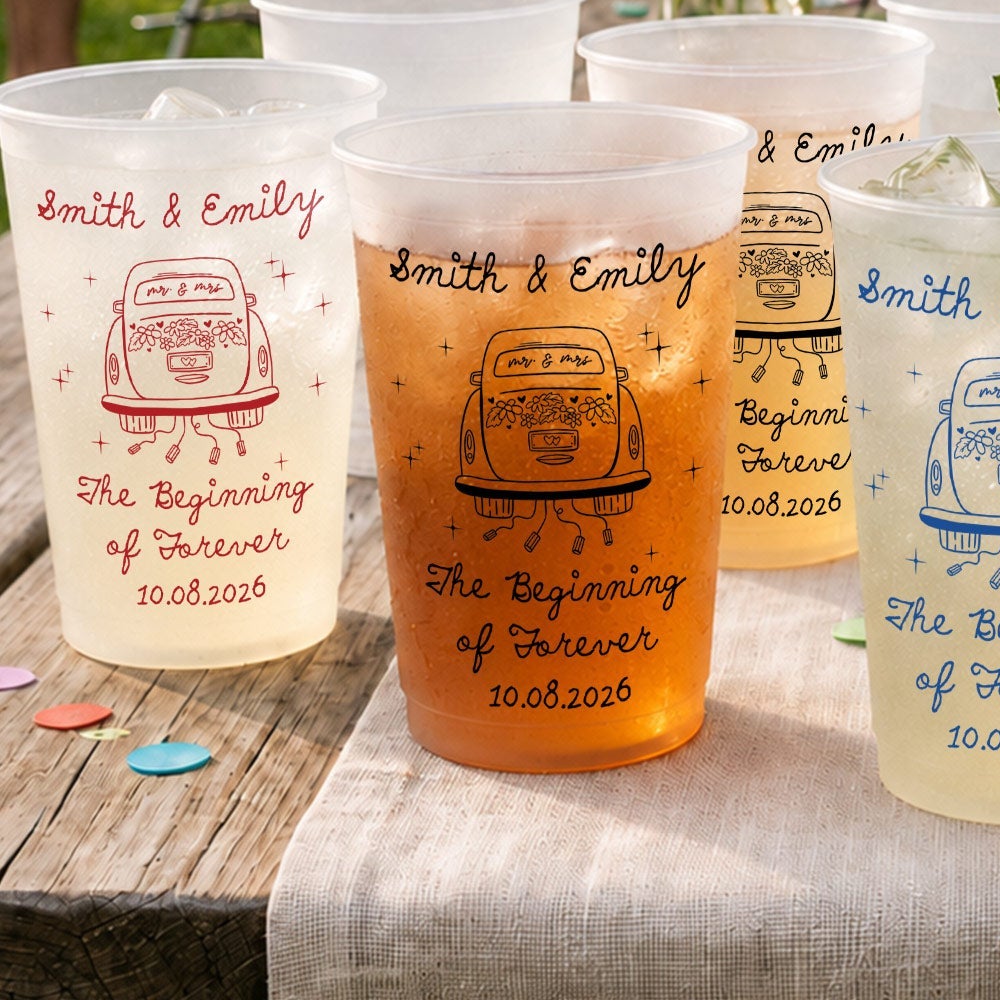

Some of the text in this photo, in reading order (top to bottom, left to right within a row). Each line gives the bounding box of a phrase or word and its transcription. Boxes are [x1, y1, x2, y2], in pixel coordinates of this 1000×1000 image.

[758, 122, 911, 163] & Emil
[38, 180, 325, 239] Smith & Emily
[769, 214, 779, 228] &
[784, 215, 813, 227] mrs
[178, 283, 188, 295] &
[195, 282, 224, 295] mrs
[389, 243, 706, 308] Smith & Emily
[858, 267, 982, 321] Smith
[542, 354, 553, 368] &
[560, 353, 592, 367] mrs
[734, 395, 849, 442] Beginni
[736, 443, 852, 473] Foreve
[77, 473, 314, 525] The Beginning
[721, 490, 842, 517] 10.08.2026
[107, 527, 290, 575] of Forever
[137, 575, 266, 606] 10.08.2026
[426, 562, 687, 620] The Beginning
[884, 597, 953, 636] The
[456, 622, 659, 673] of Forever
[488, 676, 632, 710] 10.08.2026
[915, 661, 955, 713] of
